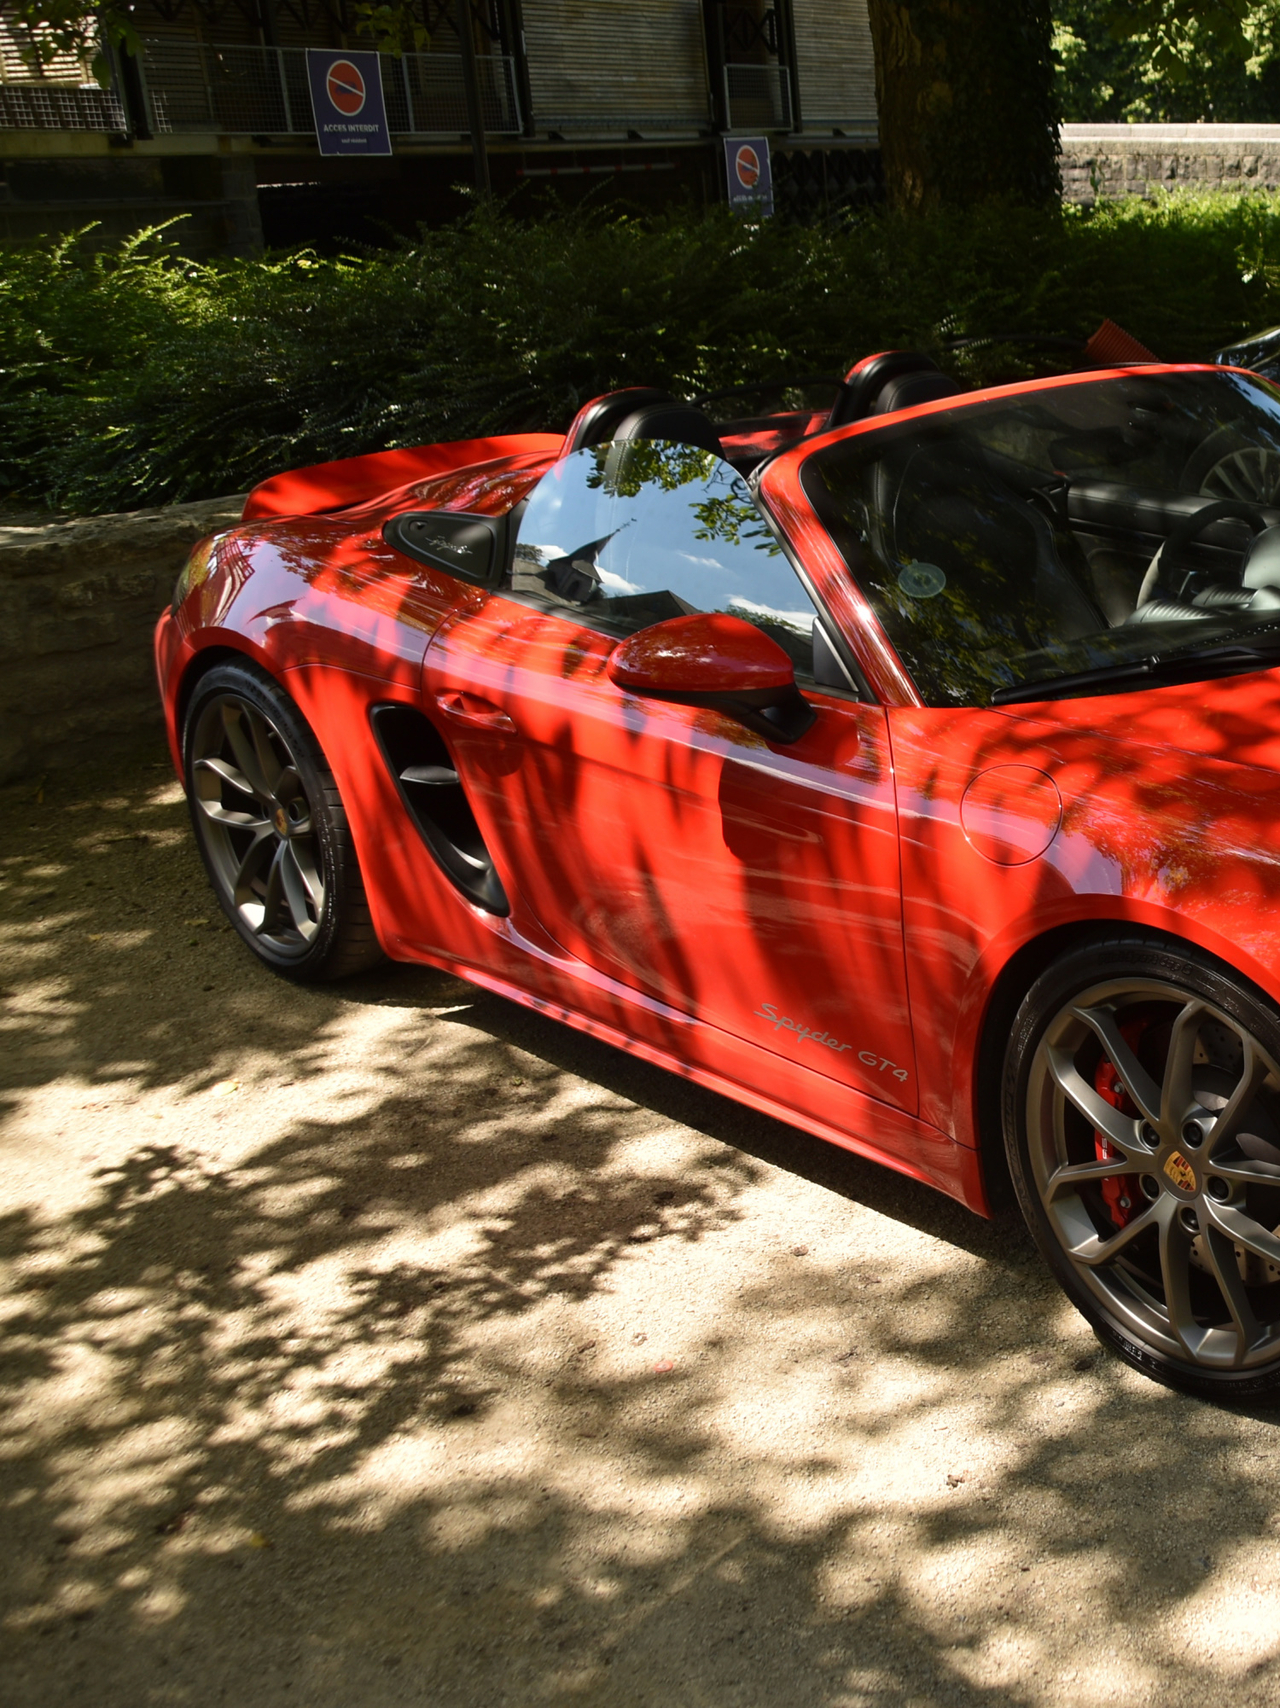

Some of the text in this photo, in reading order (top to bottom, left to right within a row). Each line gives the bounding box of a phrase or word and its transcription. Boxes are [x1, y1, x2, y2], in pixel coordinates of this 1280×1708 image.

[323, 124, 379, 133] ACCES INTERDIT
[753, 1003, 909, 1082] Spyder GT4
